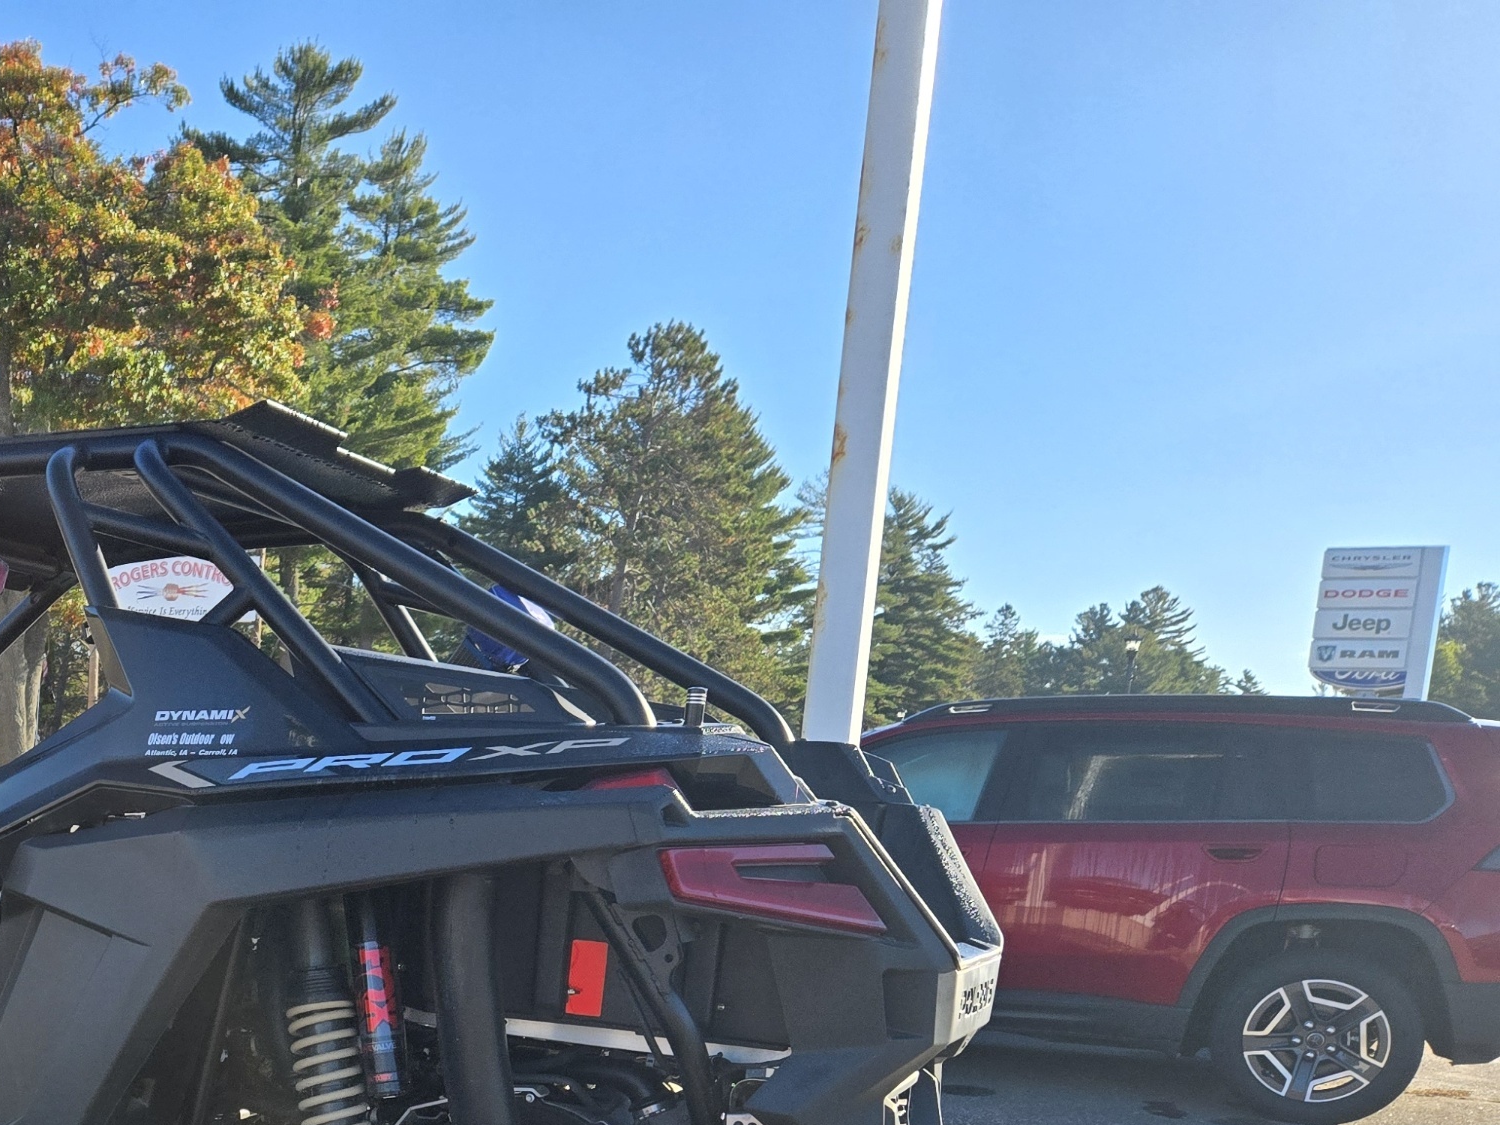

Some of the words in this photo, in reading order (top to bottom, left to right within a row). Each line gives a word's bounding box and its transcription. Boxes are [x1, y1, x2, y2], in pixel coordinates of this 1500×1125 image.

[111, 561, 169, 591] ROGERS
[171, 560, 233, 587] CONTRO
[1323, 588, 1410, 599] DODGE
[159, 608, 167, 616] Is
[169, 607, 208, 620] Everythin
[1332, 613, 1391, 635] Jeep
[1339, 649, 1400, 659] RAM
[154, 706, 251, 724] DYNAMIX
[147, 733, 179, 745] Olsen's
[179, 733, 215, 745] Outdoor
[227, 747, 473, 780] PRO
[468, 737, 632, 762] XP
